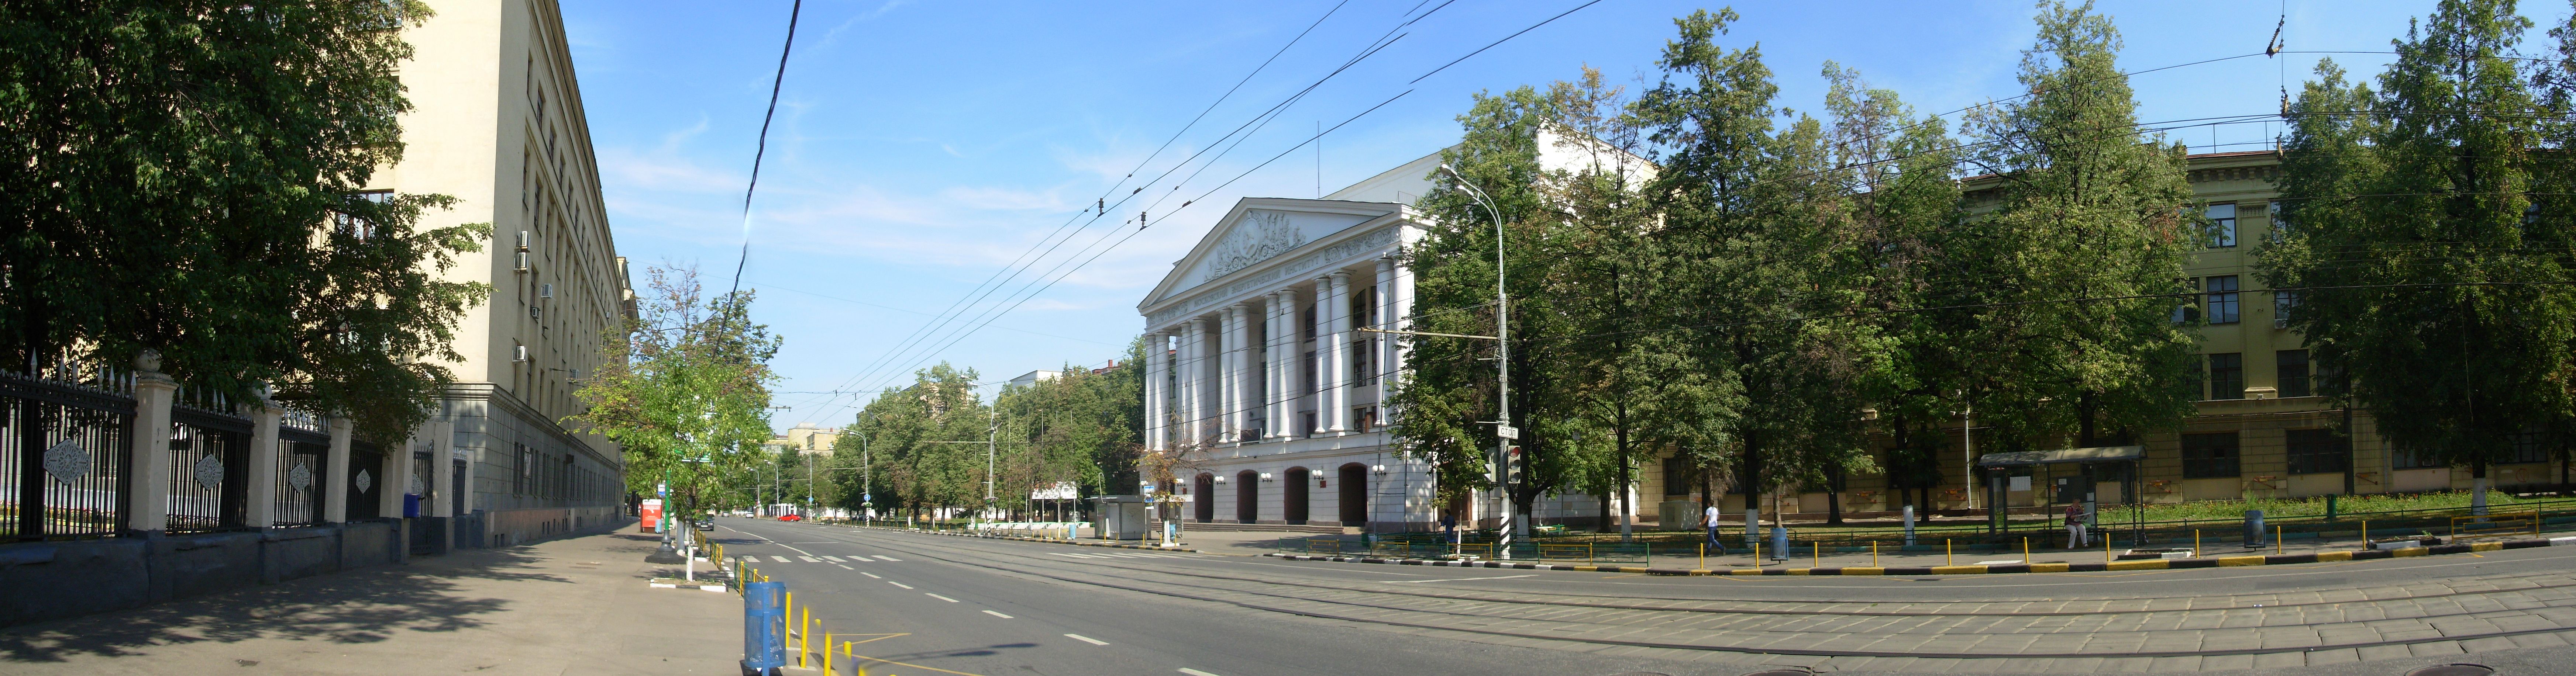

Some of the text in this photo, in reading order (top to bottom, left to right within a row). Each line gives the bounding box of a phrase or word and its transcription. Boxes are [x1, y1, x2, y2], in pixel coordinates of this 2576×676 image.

[1194, 256, 1320, 307] МОСКОВСКИЙ ЭНЕРГЕТИЧЕСКИЙ ИНСТИТУТ
[1501, 428, 1515, 436] СТОП
